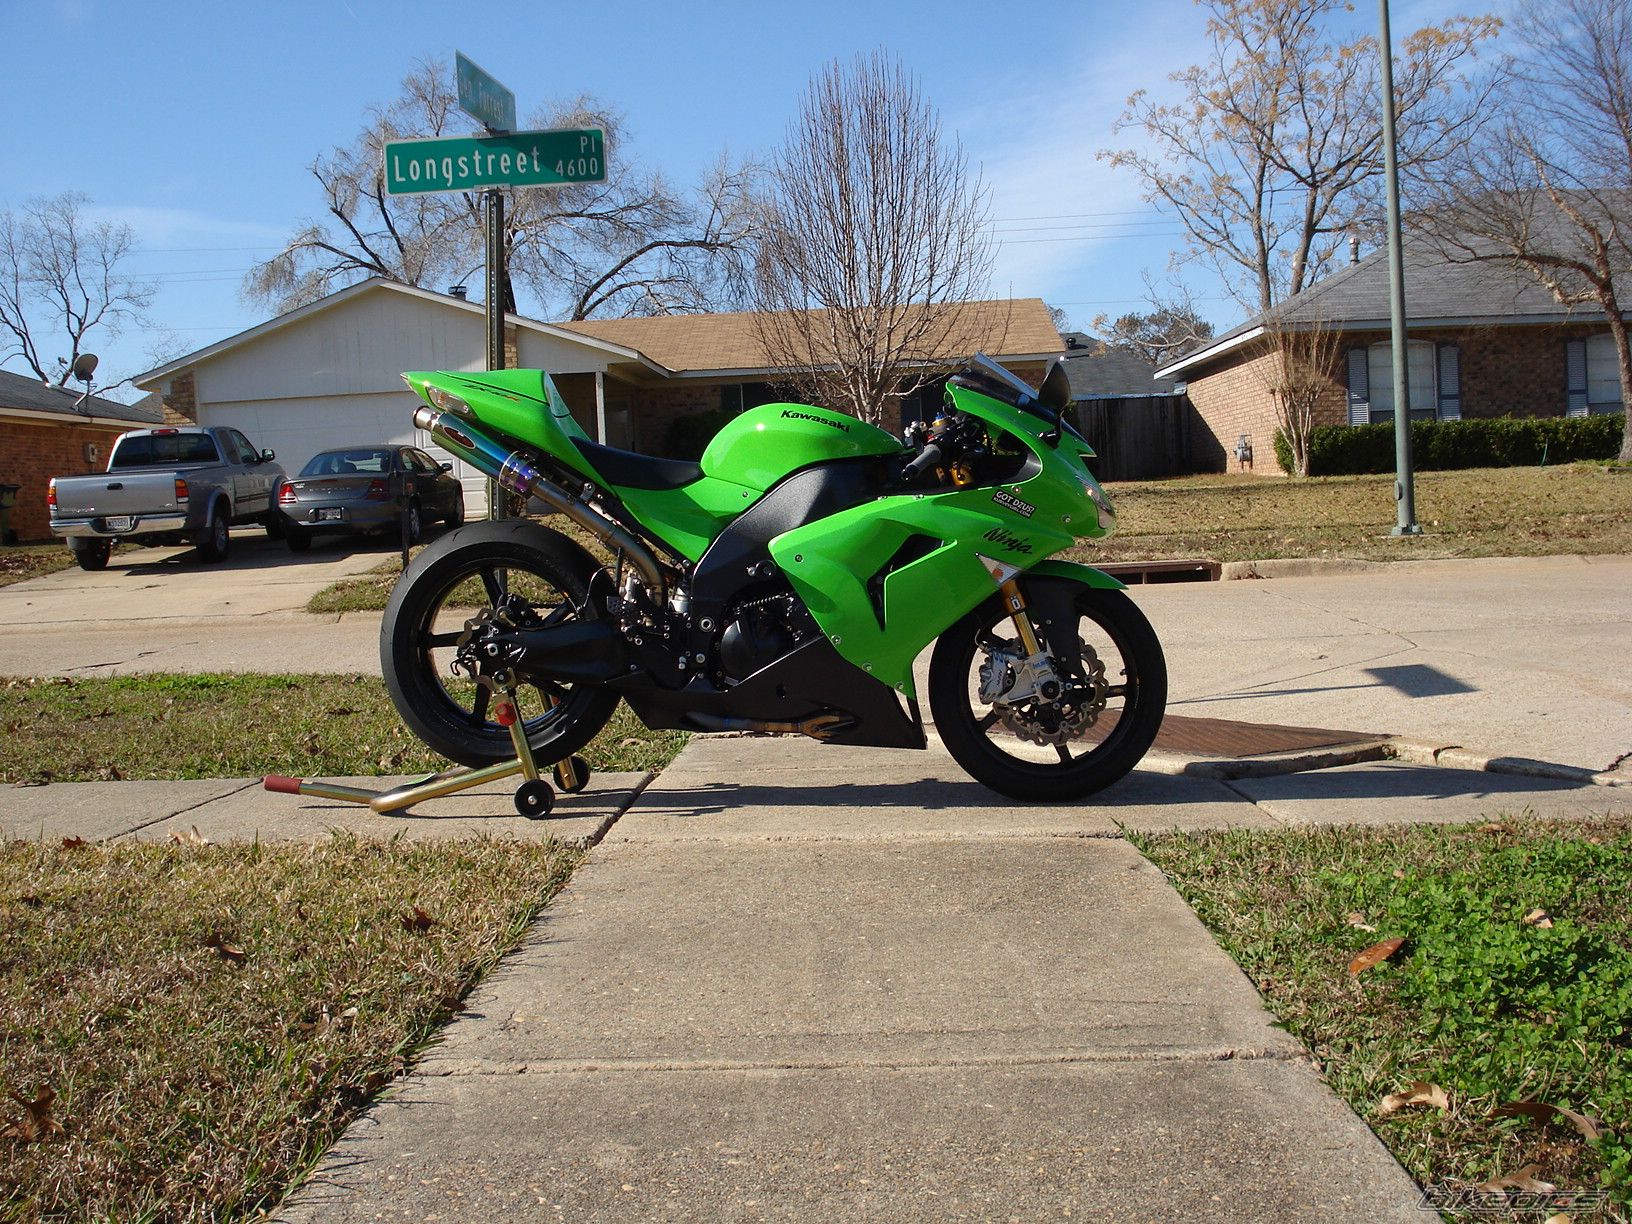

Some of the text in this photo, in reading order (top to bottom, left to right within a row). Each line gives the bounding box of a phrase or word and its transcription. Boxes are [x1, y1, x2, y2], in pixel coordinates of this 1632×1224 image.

[394, 146, 541, 187] Longstreet
[555, 157, 598, 177] 4600
[780, 409, 851, 433] Kawasaki
[996, 491, 1035, 514] GOT DZUS?
[982, 527, 1033, 554] Ninja
